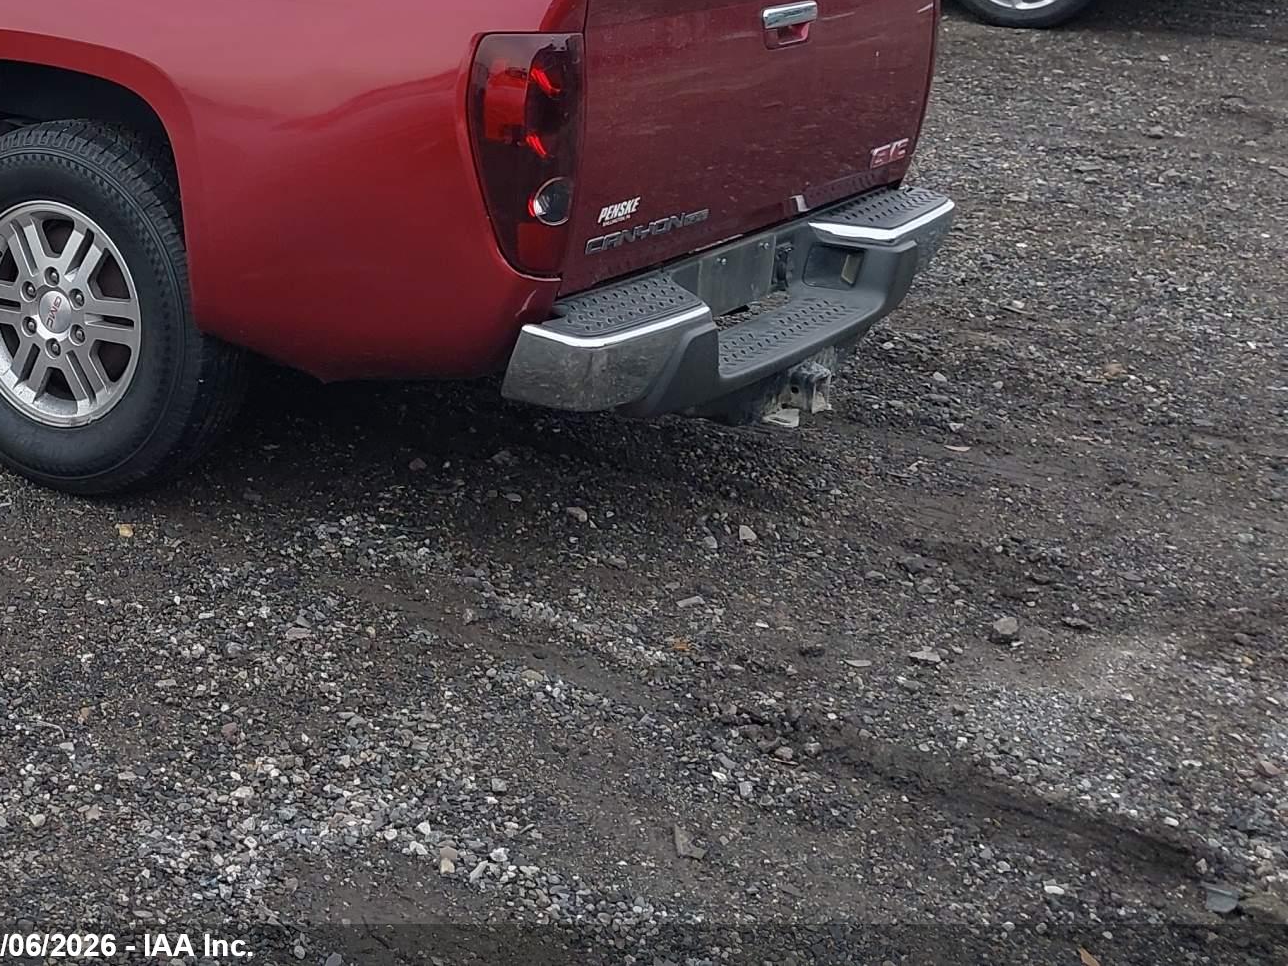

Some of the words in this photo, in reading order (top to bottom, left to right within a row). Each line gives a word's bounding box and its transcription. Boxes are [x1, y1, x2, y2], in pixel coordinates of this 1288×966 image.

[597, 196, 641, 224] PENSKE
[585, 212, 686, 255] CANYON
[45, 295, 62, 328] GMC
